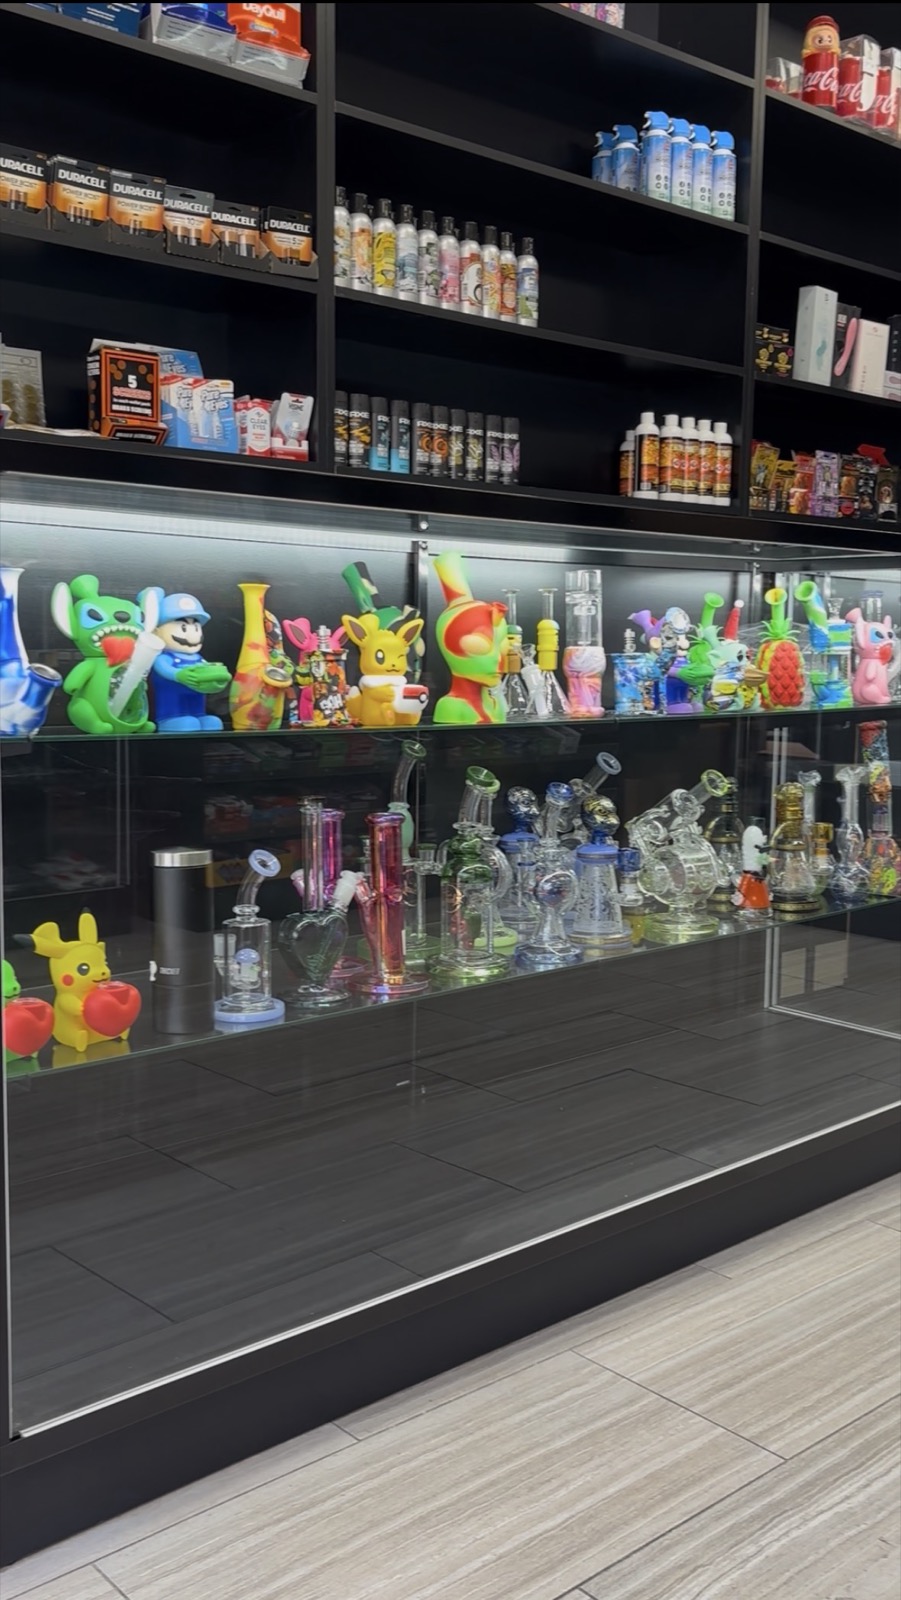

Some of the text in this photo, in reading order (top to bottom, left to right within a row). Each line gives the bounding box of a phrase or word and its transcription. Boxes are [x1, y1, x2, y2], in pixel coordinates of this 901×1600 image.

[0, 157, 44, 177] URACELL
[58, 169, 107, 189] DURACELL
[112, 183, 163, 201] DURACELL
[163, 198, 209, 214] DURACELL
[211, 212, 257, 227] DURACELL
[269, 219, 310, 233] DURACELL
[127, 374, 138, 389] 5
[350, 411, 370, 419] AXE
